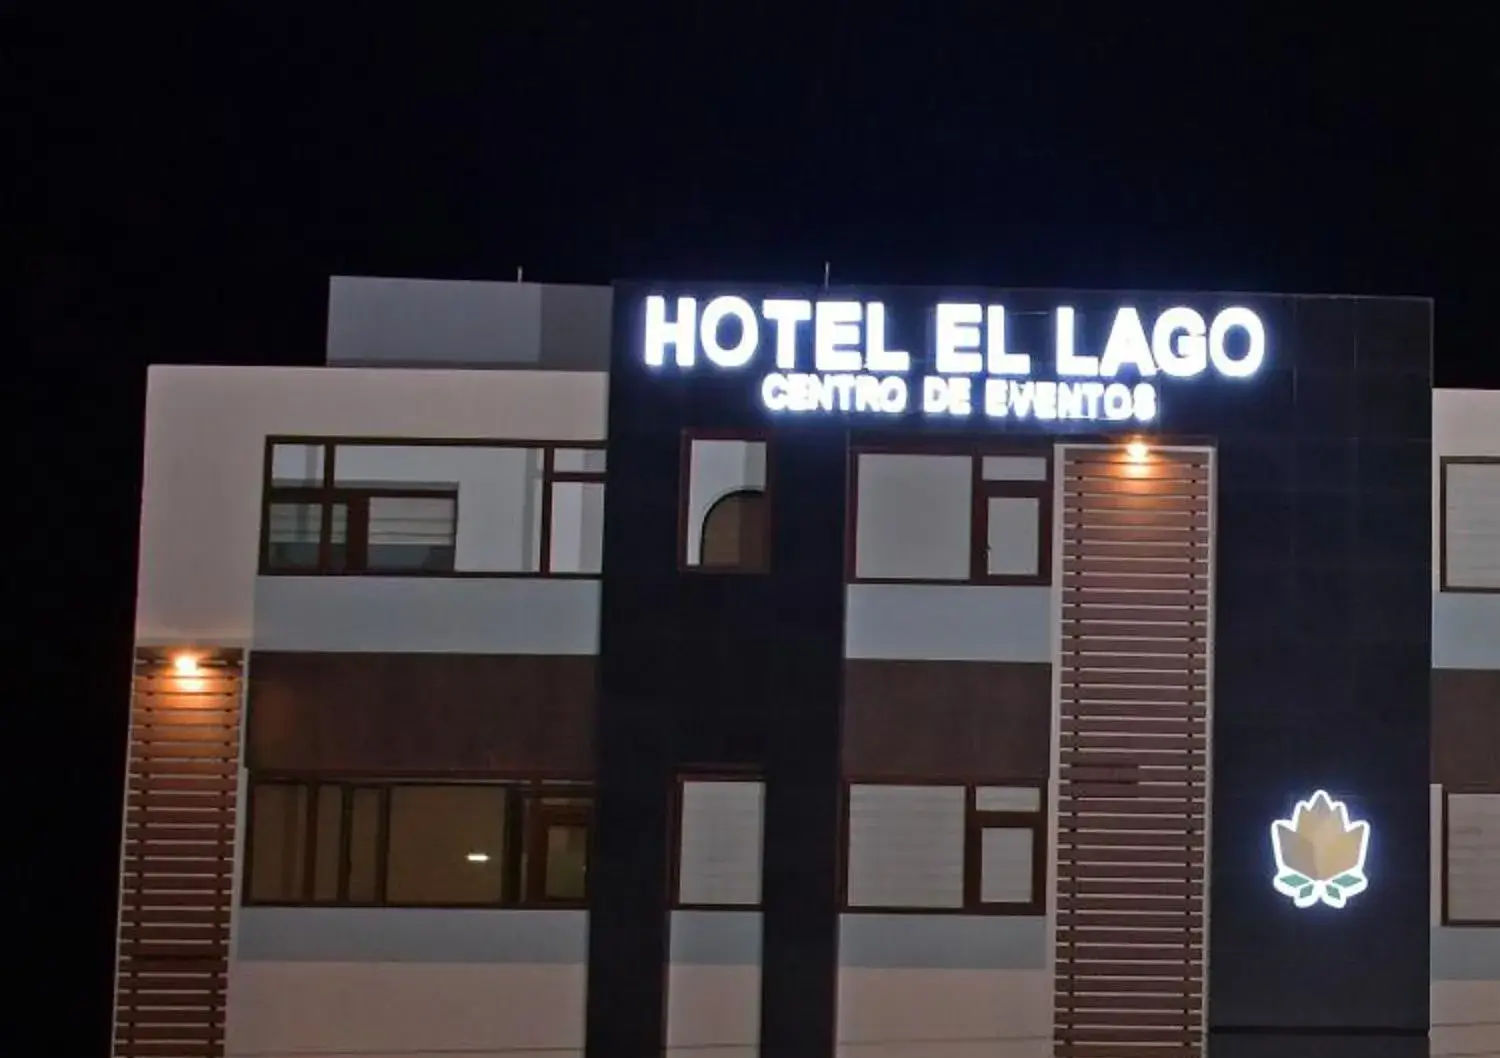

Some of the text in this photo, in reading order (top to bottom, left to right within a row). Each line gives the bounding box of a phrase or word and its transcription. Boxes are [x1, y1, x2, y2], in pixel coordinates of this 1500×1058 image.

[644, 295, 1267, 378] HOTEL EL LAGO
[761, 372, 1157, 422] CENTRO DE EVENTOS
